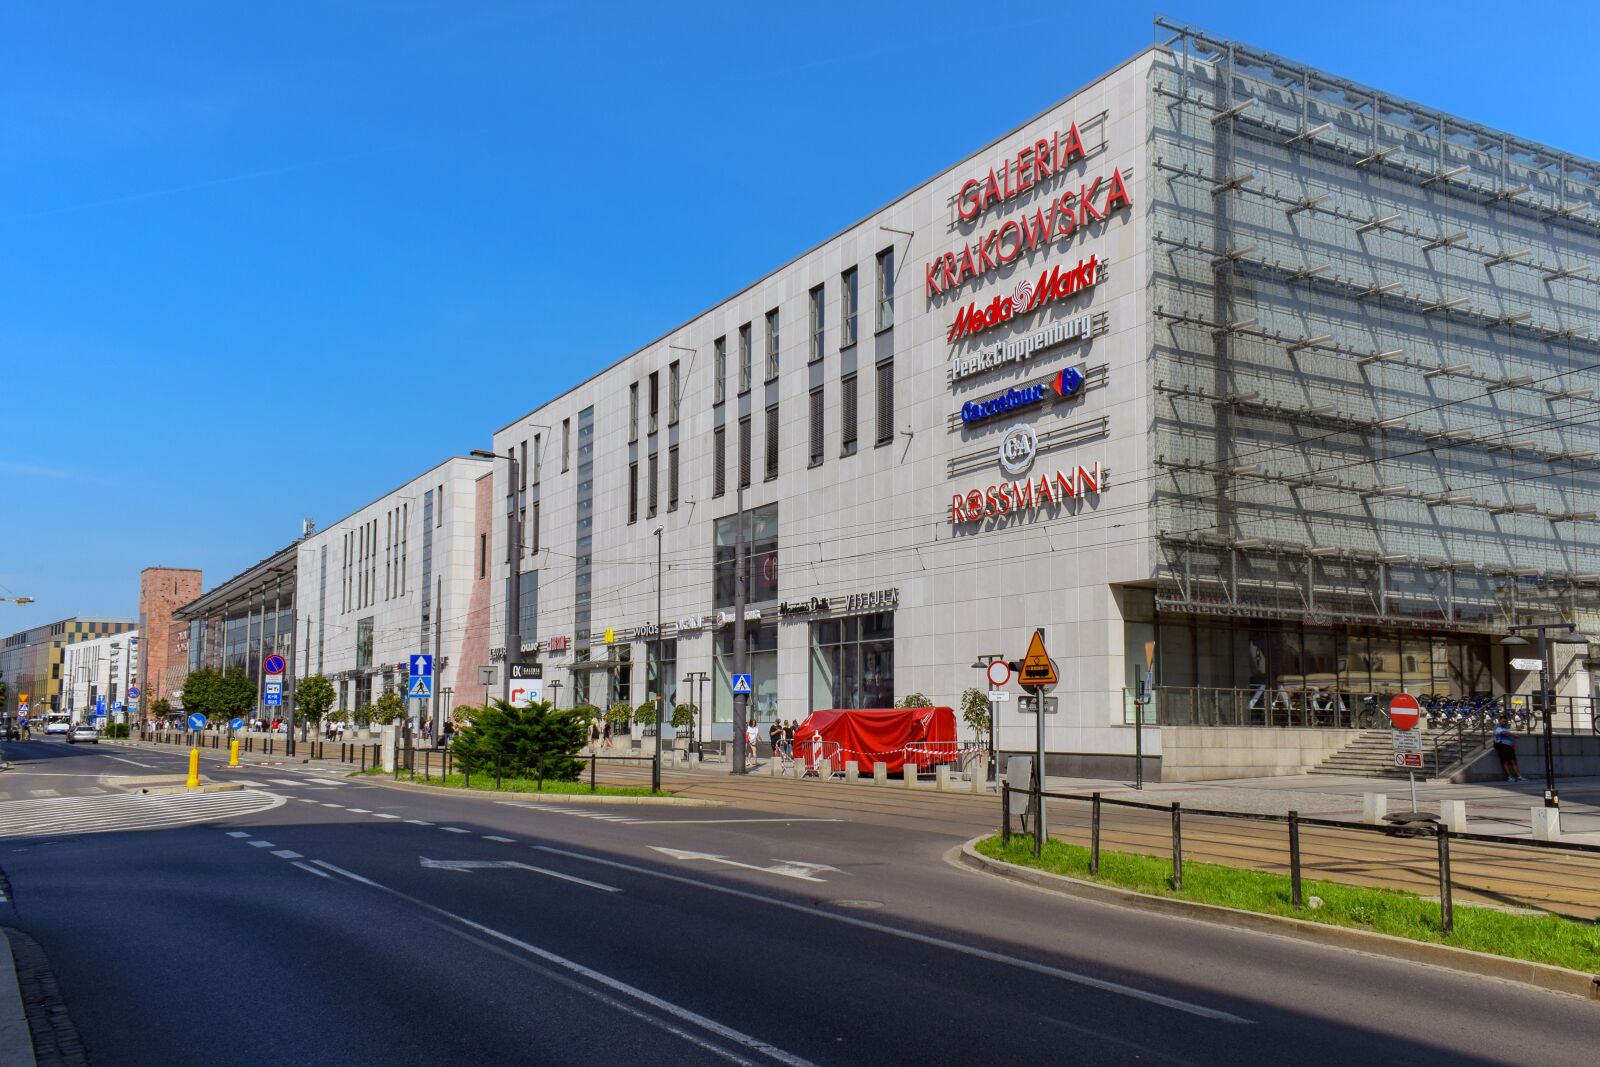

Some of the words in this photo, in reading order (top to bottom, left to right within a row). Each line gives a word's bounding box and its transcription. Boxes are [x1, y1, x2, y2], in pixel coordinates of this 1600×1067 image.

[957, 121, 1087, 219] GALERIA
[925, 166, 1132, 298] KRAKOWSKA
[947, 295, 1013, 343] Media
[1028, 254, 1101, 310] Markt
[961, 383, 1046, 423] Carrefour
[951, 461, 1102, 524] ROSSMANN
[845, 587, 898, 611] VISTULA
